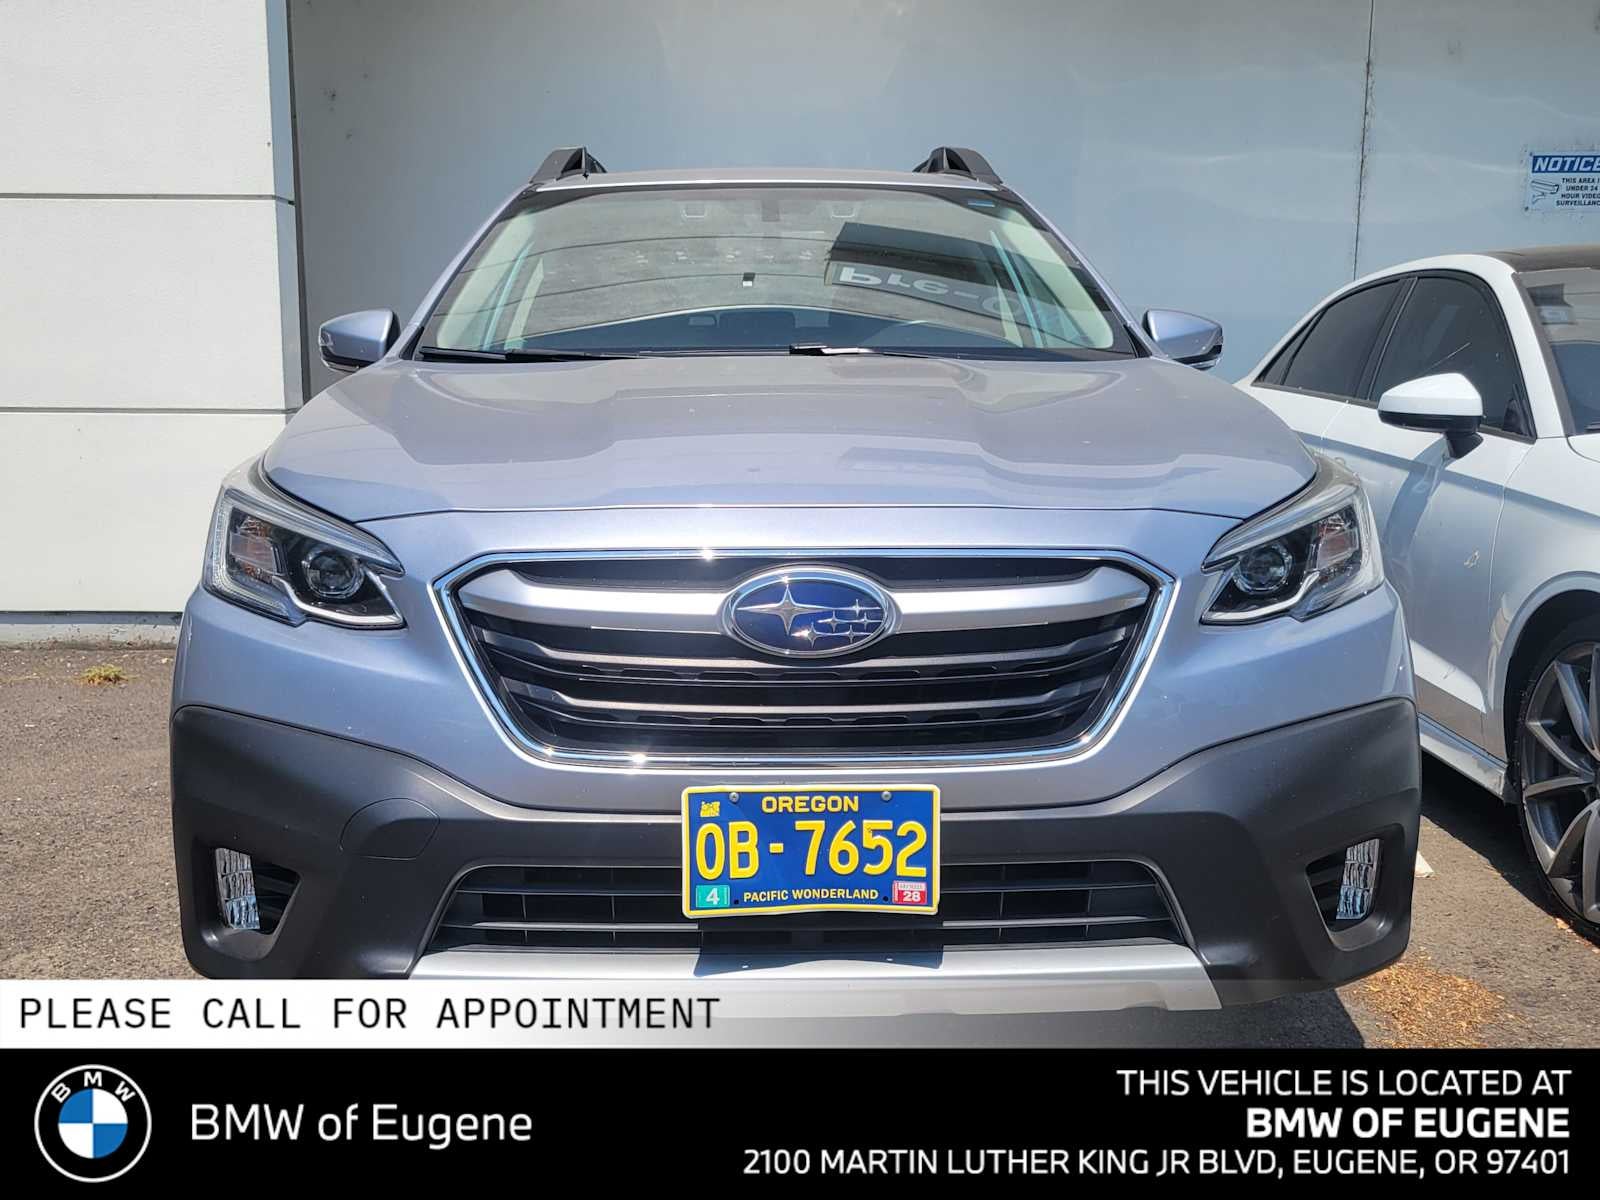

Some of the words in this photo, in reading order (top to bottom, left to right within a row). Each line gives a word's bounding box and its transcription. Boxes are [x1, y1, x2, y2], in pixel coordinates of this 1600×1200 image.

[1534, 157, 1600, 171] NOTICE
[761, 796, 859, 813] OREGON
[706, 887, 720, 905] 4
[743, 889, 789, 903] PACIFIC
[792, 888, 879, 900] WONDERLAND
[903, 891, 921, 902] 28
